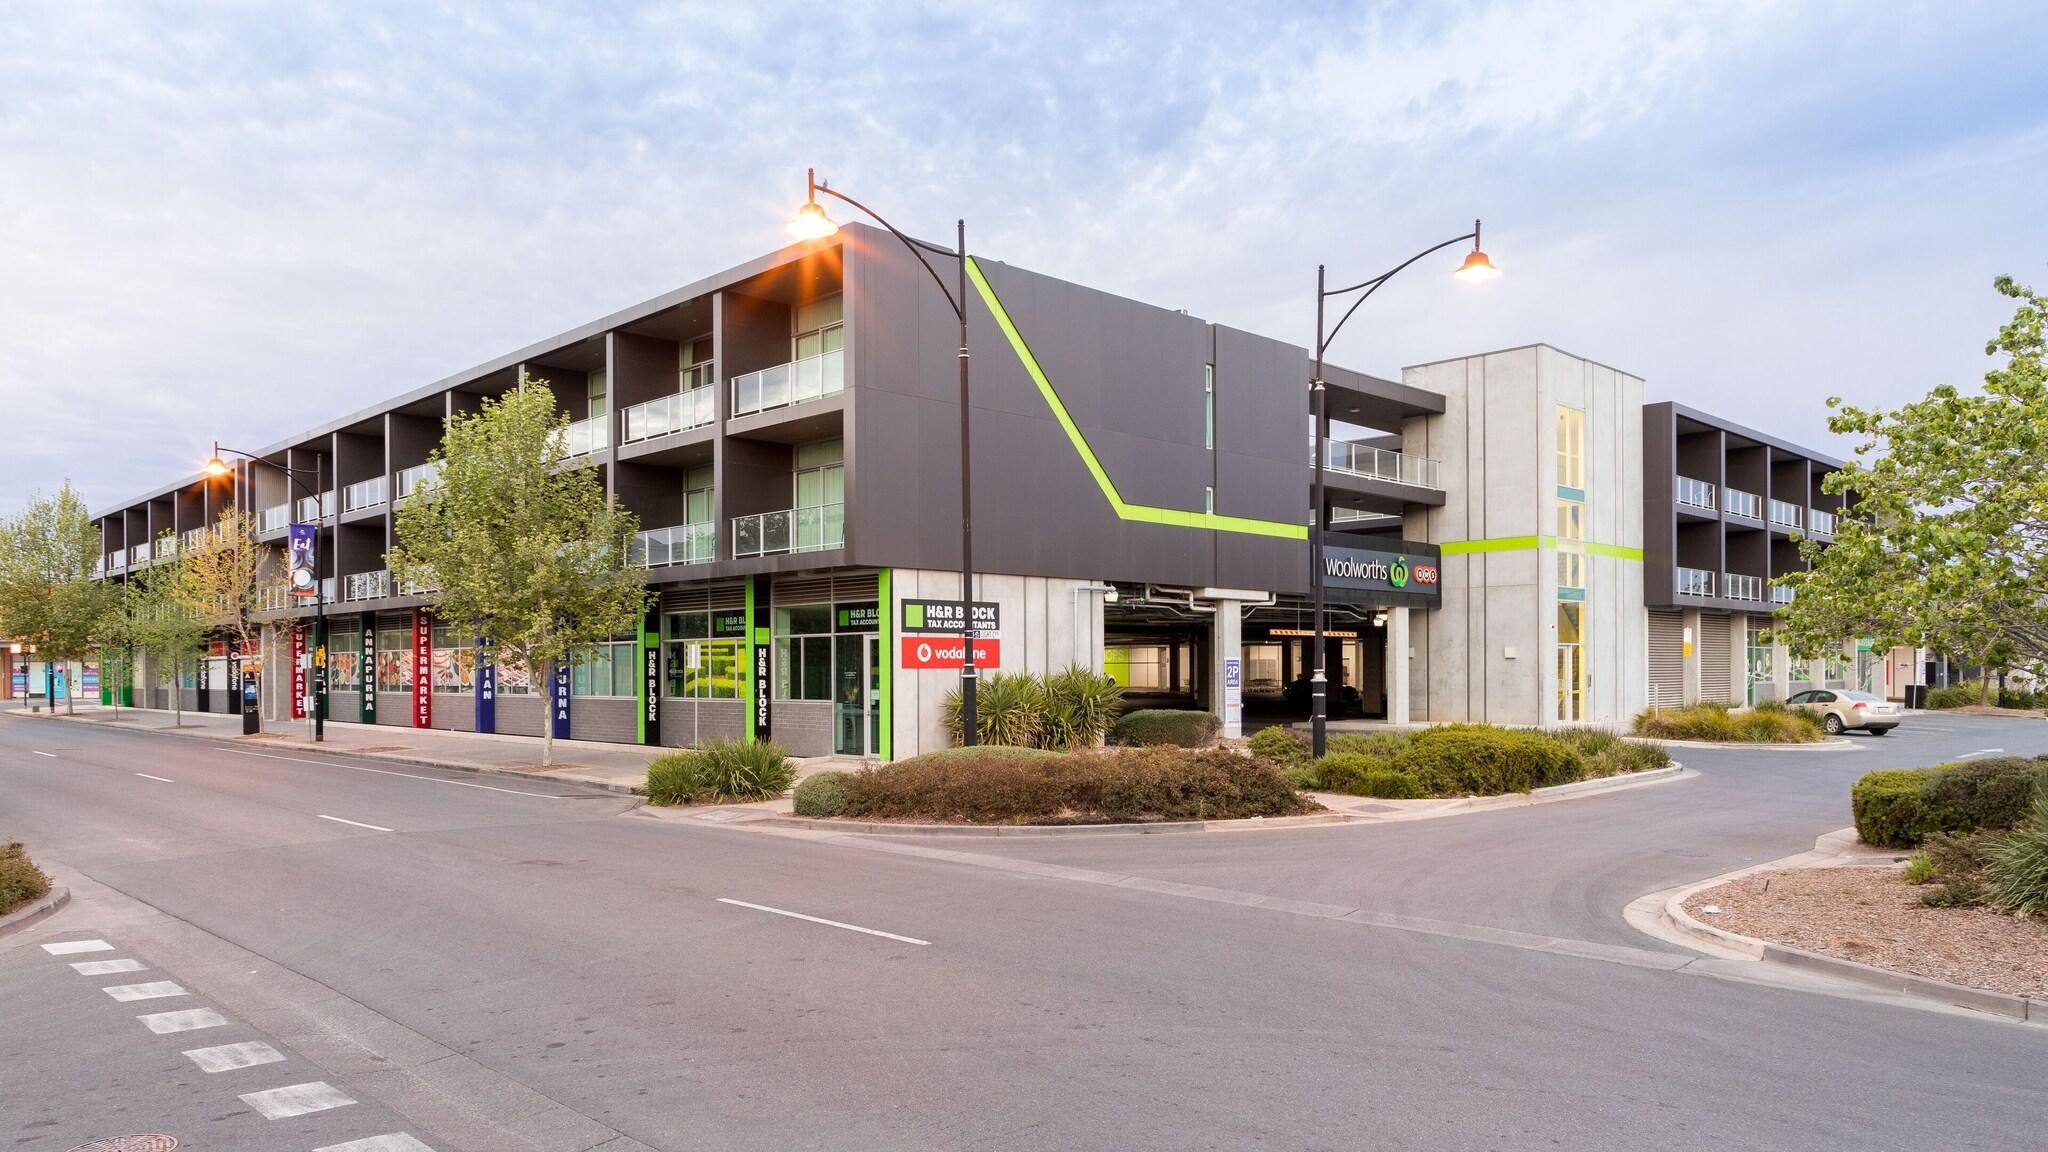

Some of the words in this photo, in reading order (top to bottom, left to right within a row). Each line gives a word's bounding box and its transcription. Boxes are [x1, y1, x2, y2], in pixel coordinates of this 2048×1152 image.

[294, 538, 311, 550] Eat
[1326, 557, 1387, 580] Woolworths
[725, 616, 737, 625] H&R
[850, 609, 866, 618] H&R
[927, 605, 953, 618] H&R
[956, 606, 995, 619] BOCK
[927, 620, 942, 628] TAX
[943, 620, 996, 629] ACCOTANTS
[935, 646, 986, 659] vodane
[365, 629, 373, 710] ANNAPURNA
[420, 617, 428, 724] SUPERMARKET
[648, 651, 656, 676] H&R
[758, 648, 767, 676] H&R
[1227, 666, 1239, 678] 2P
[648, 680, 656, 721] BLOCK
[758, 680, 767, 726] BLOCK
